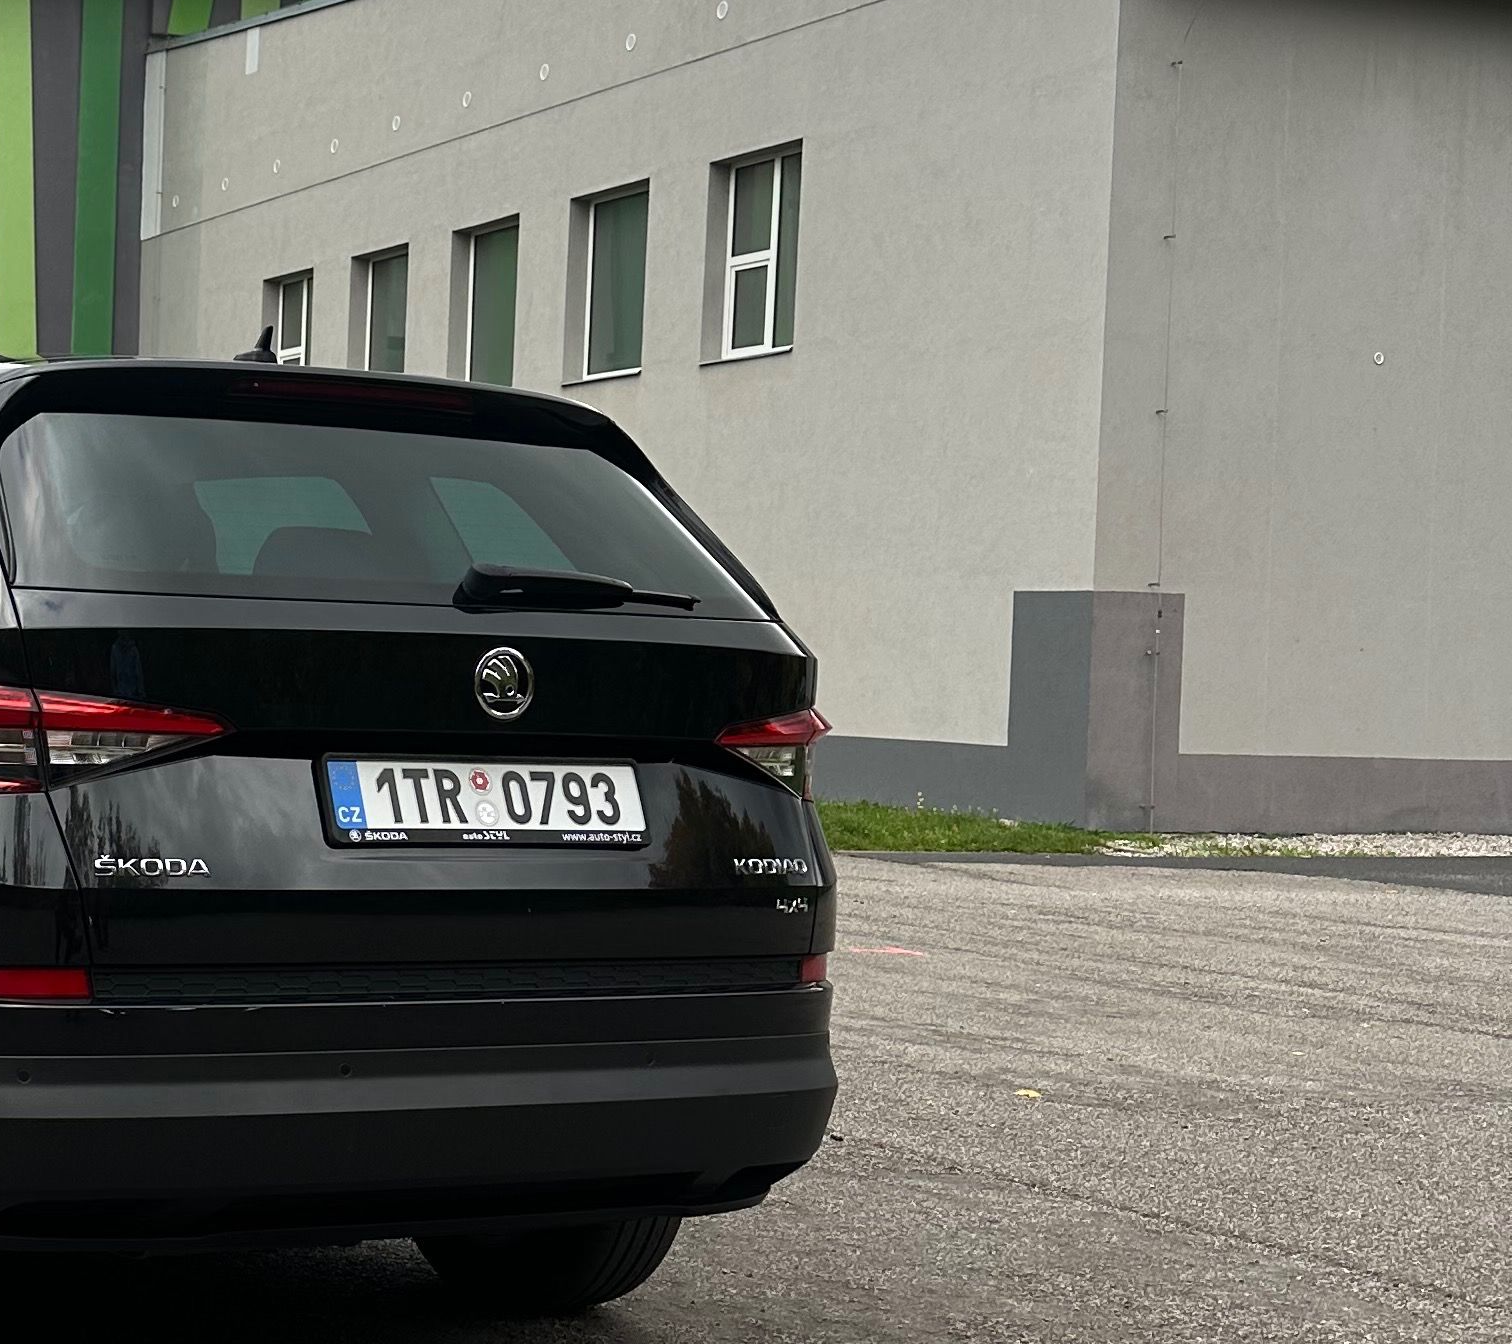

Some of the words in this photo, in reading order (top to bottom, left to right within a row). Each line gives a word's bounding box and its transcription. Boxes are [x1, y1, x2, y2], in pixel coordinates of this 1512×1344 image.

[375, 767, 469, 825] 1TR
[501, 769, 622, 826] 0793
[337, 806, 363, 823] CZ
[364, 830, 409, 841] ŠKODA
[94, 854, 212, 878] ŠKODA
